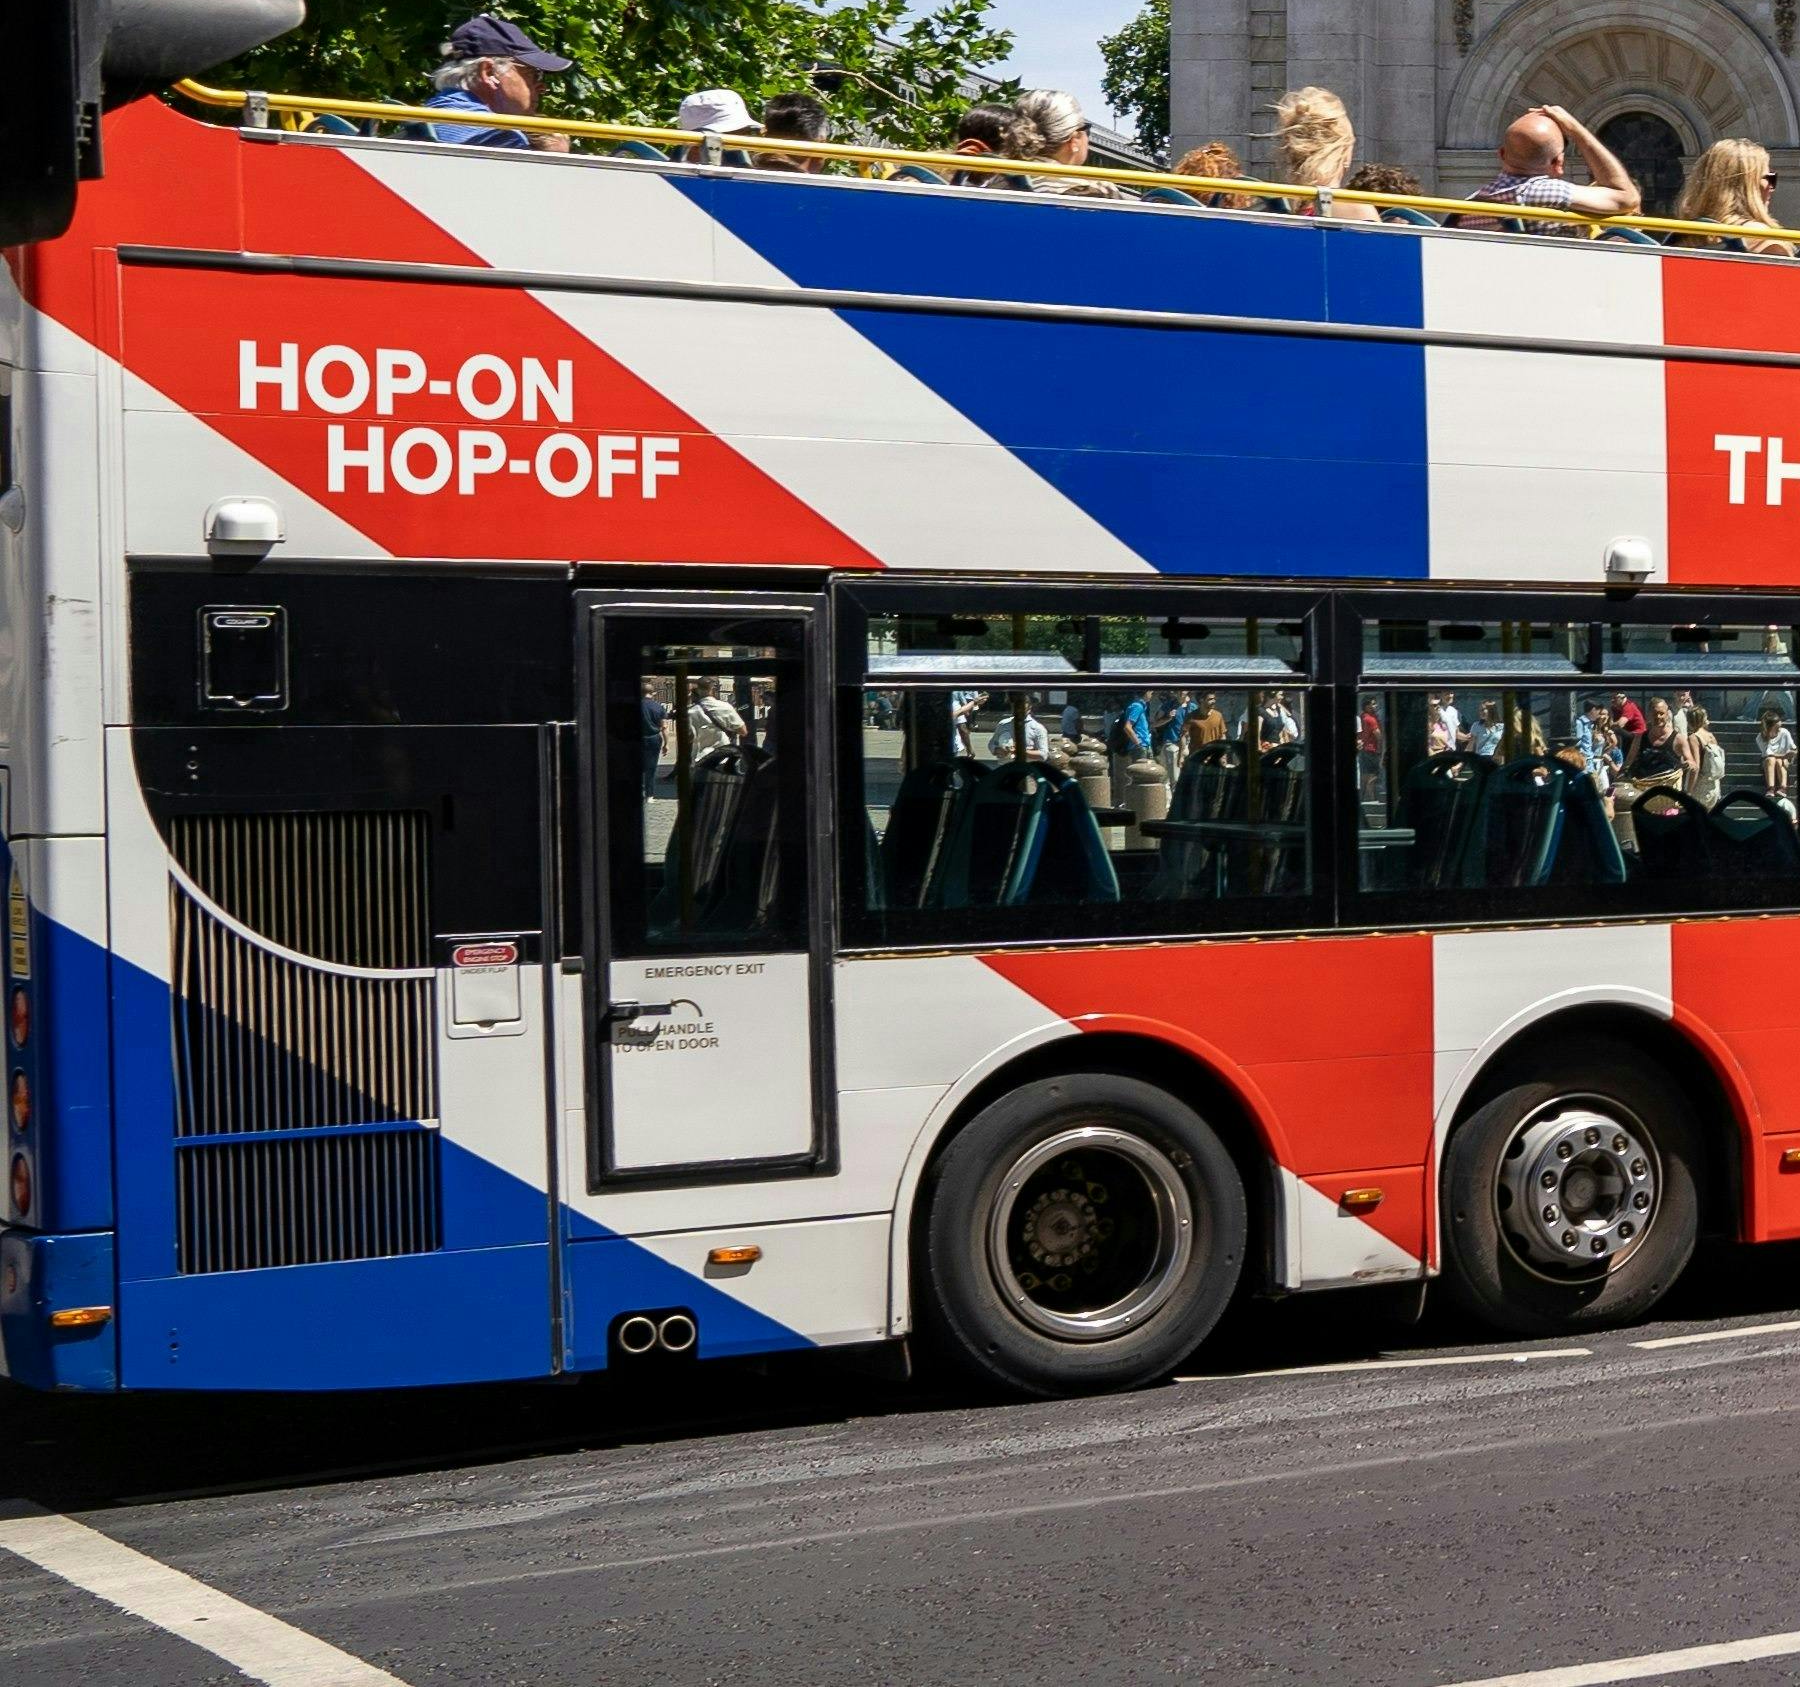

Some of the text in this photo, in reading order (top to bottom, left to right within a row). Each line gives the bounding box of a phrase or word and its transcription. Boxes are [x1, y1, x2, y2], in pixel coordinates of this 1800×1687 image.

[239, 340, 573, 423] HOP-ON
[327, 424, 680, 499] HOP-OFF
[645, 963, 765, 979] EMERGENCY EXIT
[658, 1022, 714, 1037] HANDLE
[615, 1037, 719, 1054] TO OPEN DOOR
